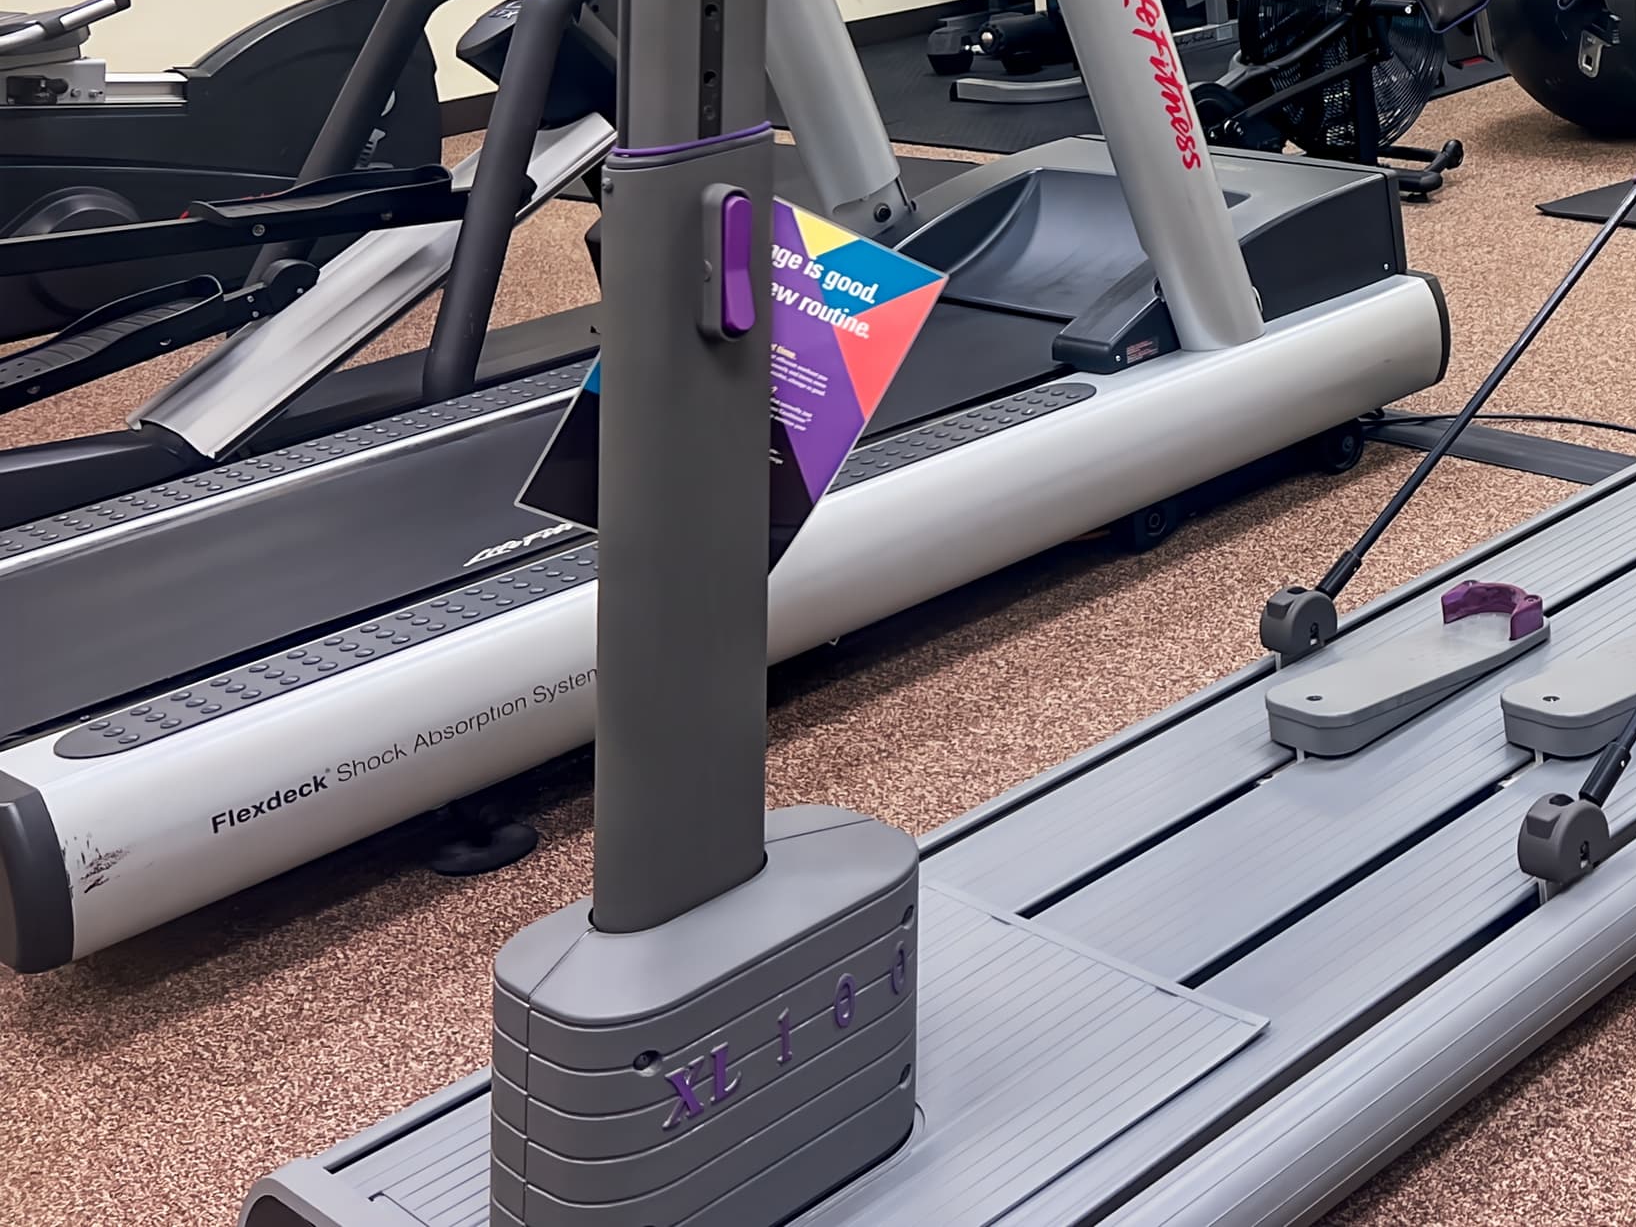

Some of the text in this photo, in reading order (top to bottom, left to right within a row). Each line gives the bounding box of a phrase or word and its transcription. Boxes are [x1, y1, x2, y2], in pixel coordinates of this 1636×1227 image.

[803, 257, 825, 279] is
[822, 270, 879, 304] good.
[798, 296, 870, 339] routine.
[211, 774, 328, 834] Flexdeck
[337, 743, 409, 783] Shock
[413, 695, 527, 754] Absorption
